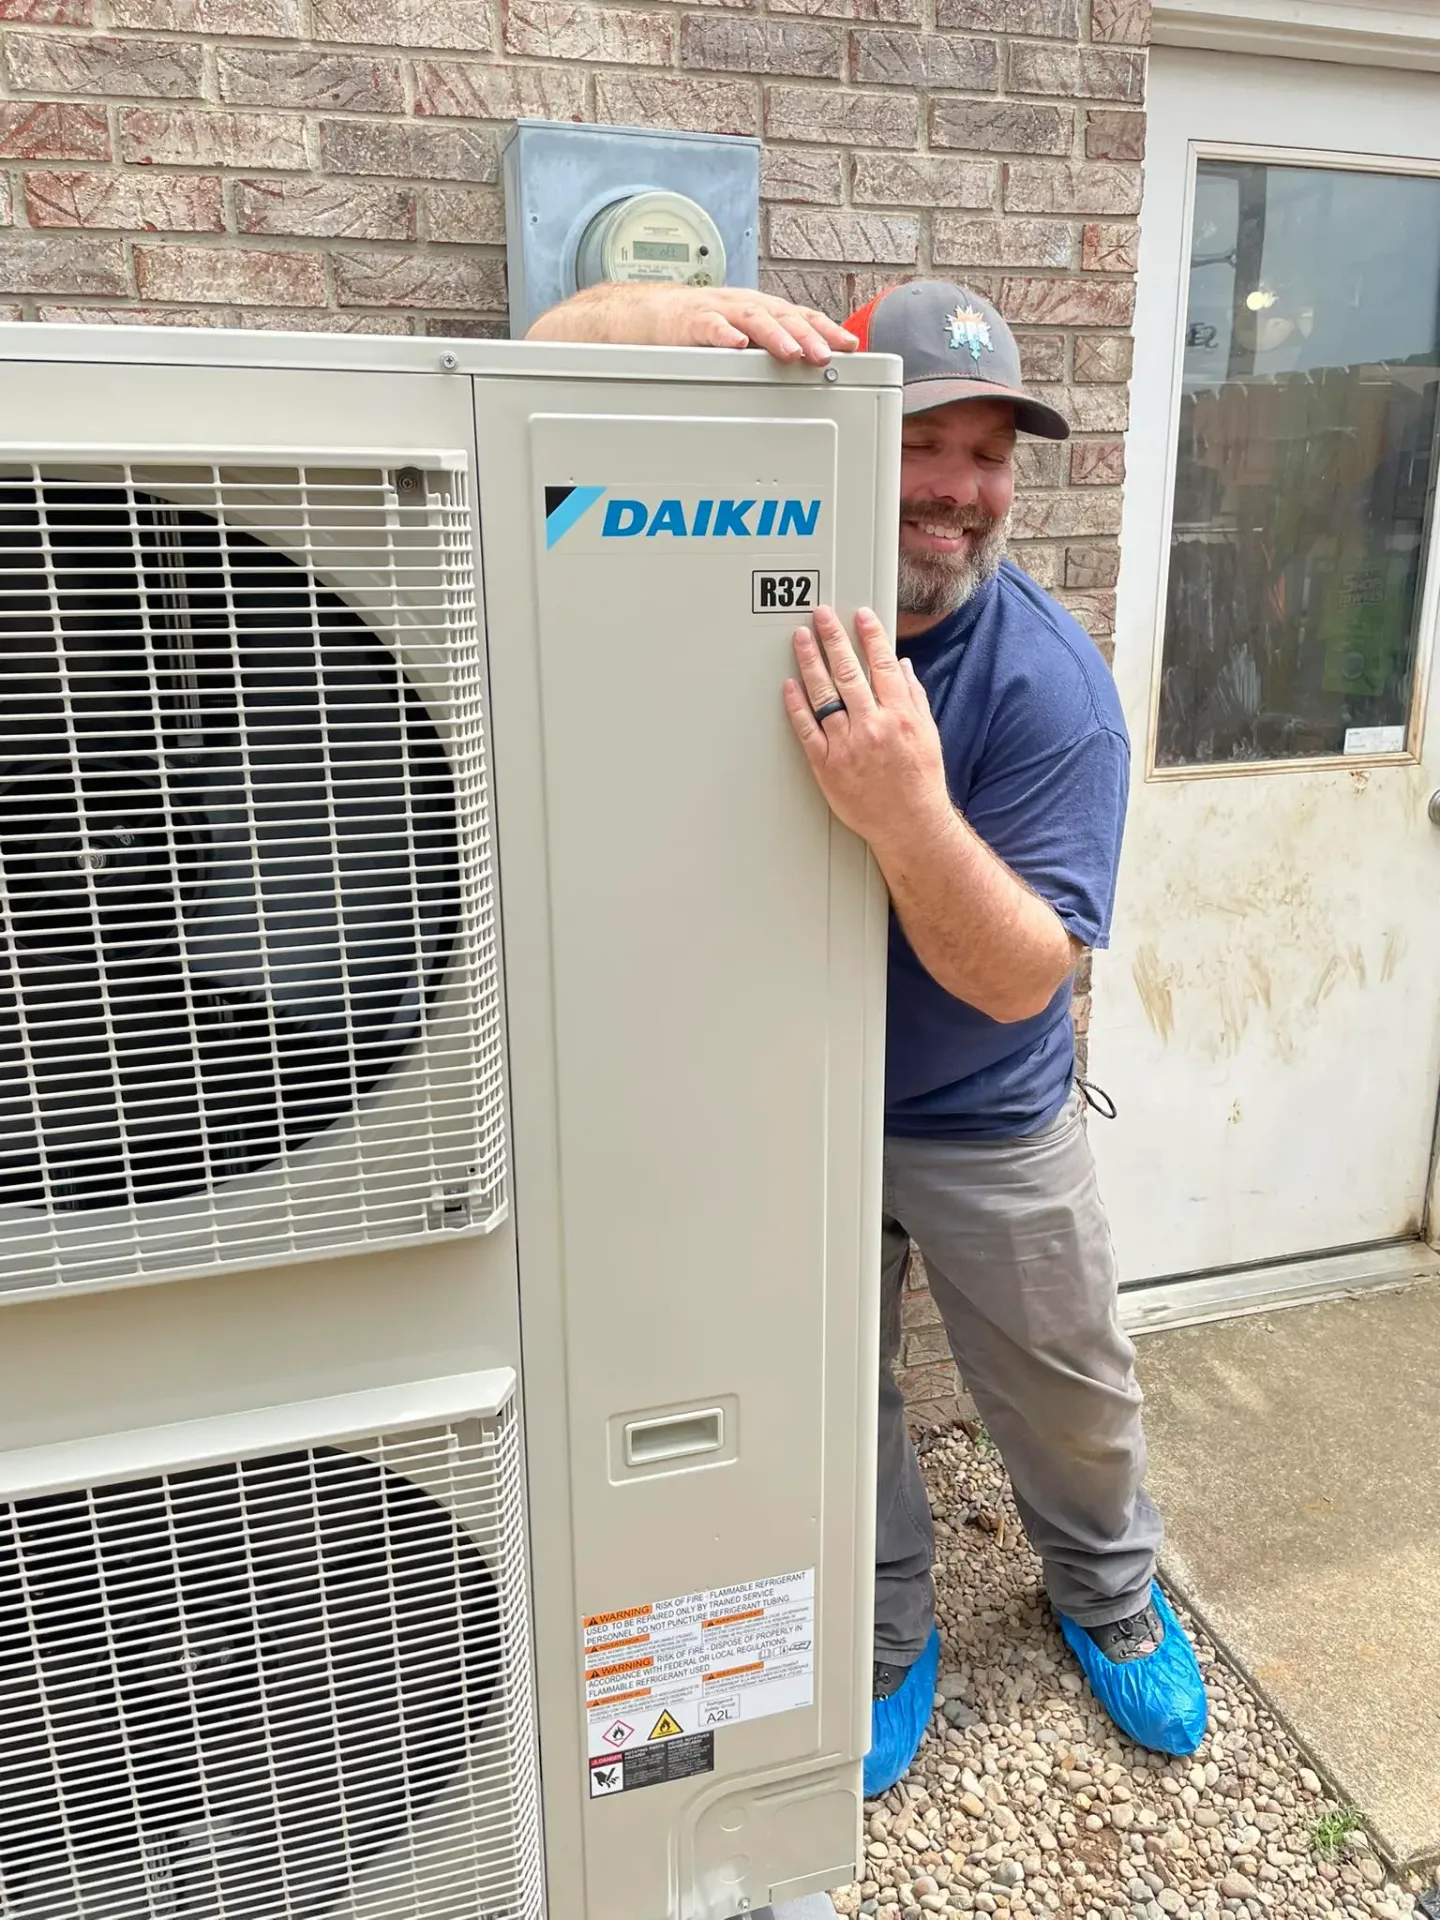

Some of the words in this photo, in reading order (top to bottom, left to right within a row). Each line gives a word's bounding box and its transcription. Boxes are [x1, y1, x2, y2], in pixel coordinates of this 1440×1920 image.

[601, 500, 821, 536] DAIKIN
[760, 577, 811, 607] R32
[586, 1625, 608, 1636] USED
[624, 1619, 634, 1627] BE
[636, 1610, 674, 1624] REPAIRED
[676, 1606, 695, 1616] ONLY
[697, 1602, 707, 1612] BY
[709, 1596, 741, 1608] TRAINED
[743, 1589, 774, 1601] SERVICE
[599, 1606, 649, 1623] WARNING
[655, 1602, 673, 1610] RISK
[675, 1598, 685, 1606] OF
[687, 1593, 704, 1604] FIRE
[710, 1583, 753, 1599] FLAMMABLE
[755, 1572, 806, 1589] REFRIGERANT
[637, 1625, 648, 1634] DO
[650, 1623, 666, 1632] NOT
[667, 1612, 709, 1627] PUNCTURE
[710, 1601, 761, 1618] REFRIGERANT
[589, 1670, 641, 1688] ACCORDANCE
[643, 1666, 662, 1675] WITH
[664, 1659, 697, 1671] FEDERAL
[698, 1654, 710, 1663] OR
[712, 1650, 734, 1660] LOCAL
[602, 1659, 650, 1675] WARNING
[657, 1654, 674, 1662] RISK
[676, 1651, 686, 1659] OF
[687, 1646, 704, 1657] FIRE
[711, 1638, 742, 1651] DISPOSE
[744, 1635, 753, 1643] OF
[756, 1627, 793, 1640] PROPERLY
[589, 1681, 634, 1698] FLAMMABLE
[636, 1669, 688, 1687] REFRIGERANT
[690, 1664, 710, 1674] USED
[707, 1709, 732, 1724] A2L
